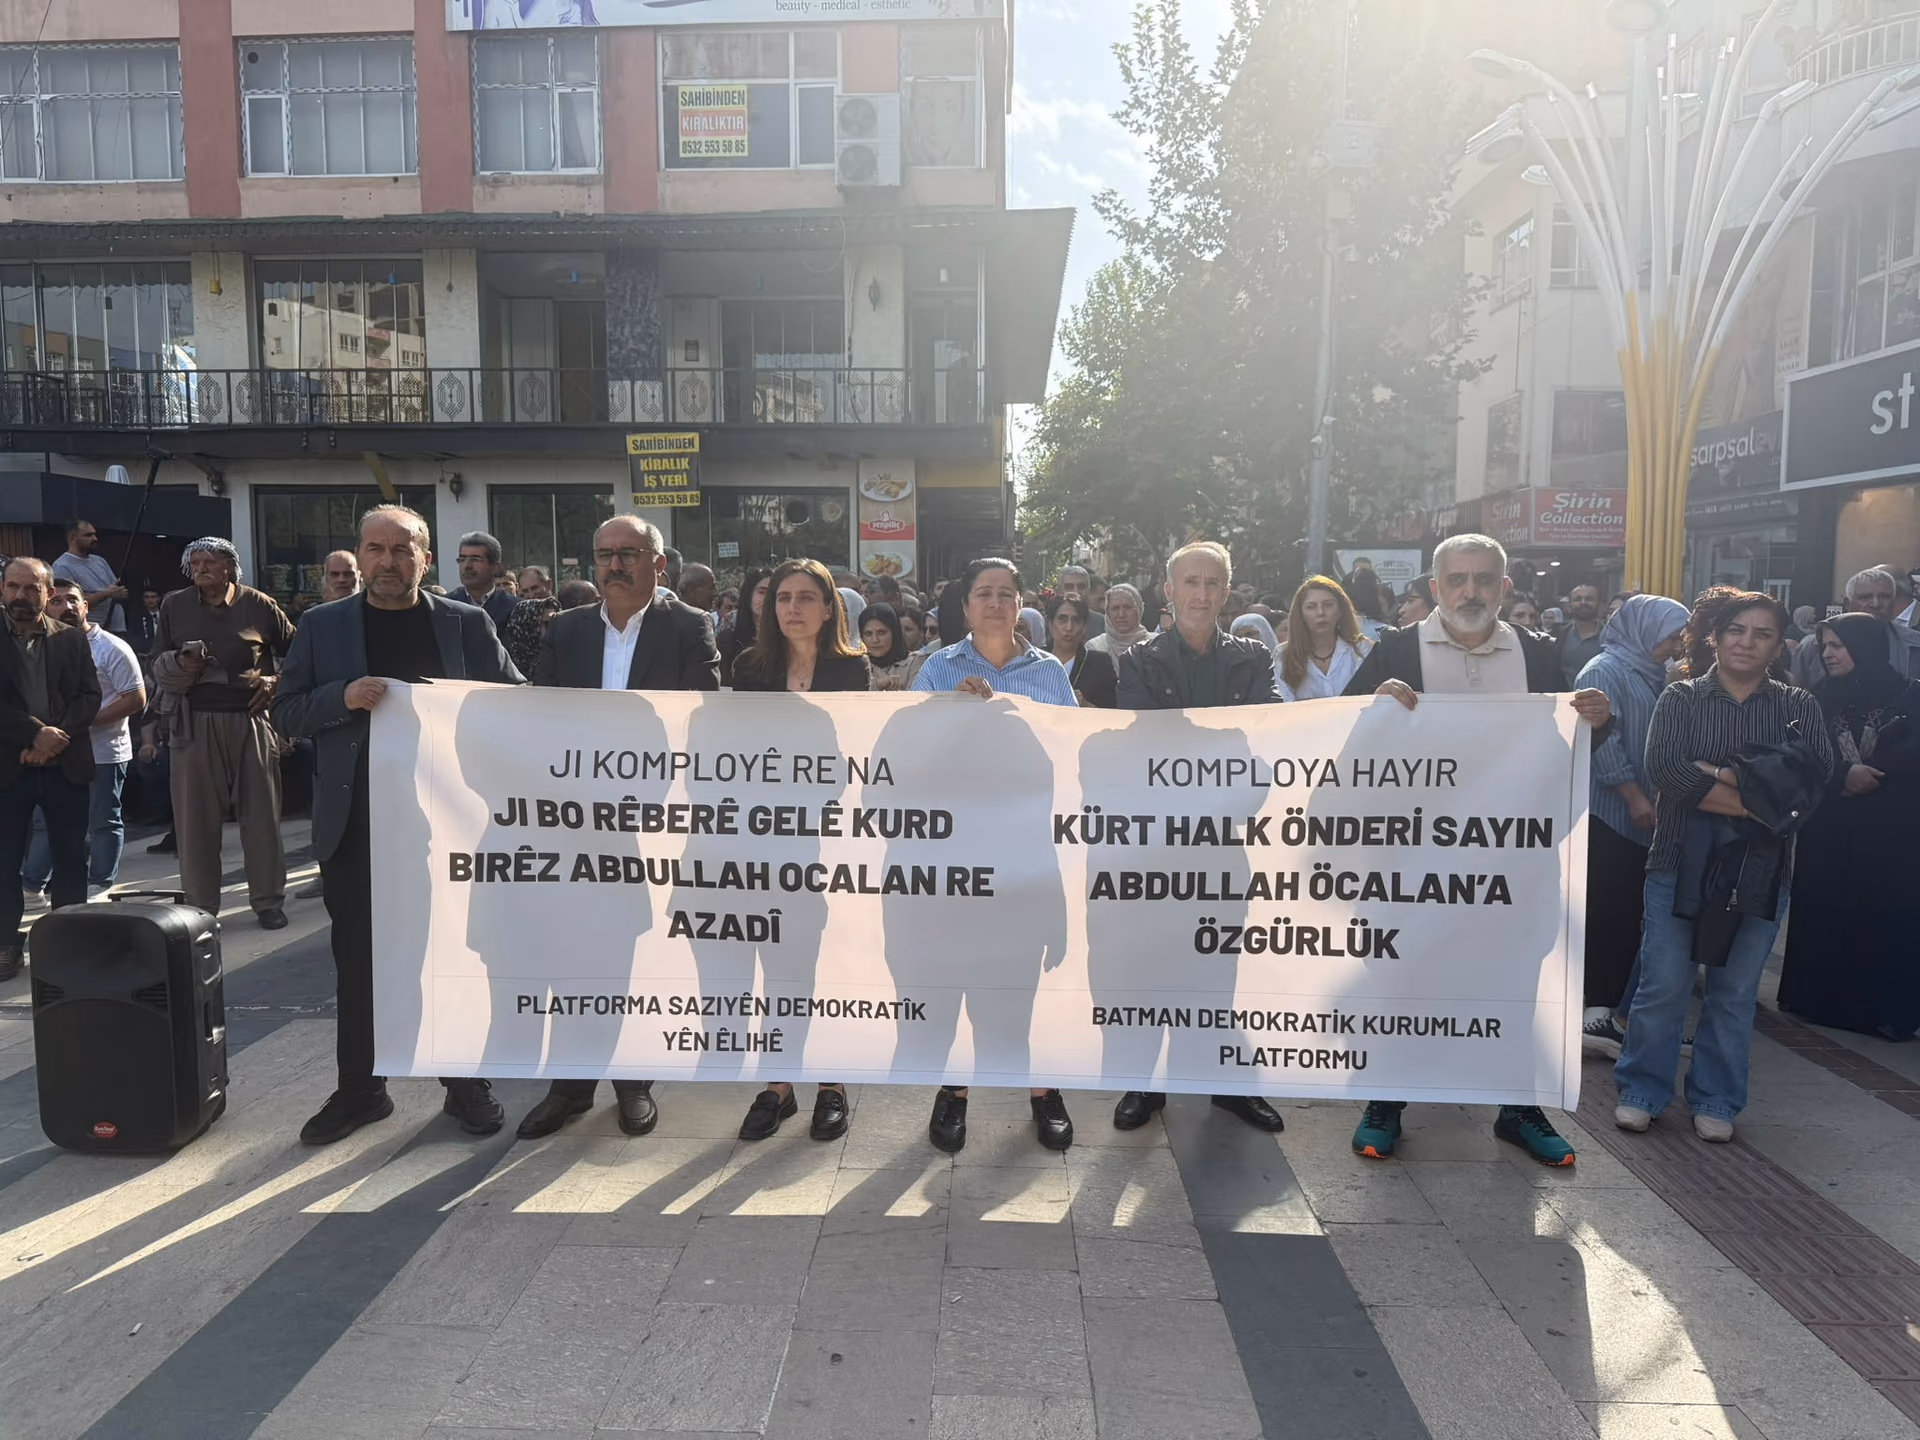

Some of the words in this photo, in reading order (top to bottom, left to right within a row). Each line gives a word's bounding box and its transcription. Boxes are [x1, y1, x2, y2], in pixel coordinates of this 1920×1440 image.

[775, 0, 811, 13] beauty
[820, 0, 861, 10] medical
[680, 88, 745, 106] SAHİBİNDEN
[682, 140, 703, 154] 0532
[704, 139, 720, 153] 553
[722, 139, 732, 153] 58
[735, 139, 745, 153] 85
[632, 436, 695, 451] SAHİBİNDEN
[640, 457, 690, 471] KİRALIK
[659, 472, 688, 487] YERİ
[633, 495, 656, 505] 0532
[658, 495, 674, 505] 553
[676, 494, 688, 504] 58
[1553, 492, 1611, 512] Şirin
[1540, 512, 1623, 524] Collection
[550, 750, 581, 778] JI
[594, 747, 781, 782] KOMPLOYÊ
[793, 755, 836, 784] RE
[848, 757, 894, 785] NA
[1149, 759, 1340, 787] KOMPLOYA
[1353, 759, 1457, 787] HAYIR
[494, 798, 528, 826] JI
[536, 799, 584, 829] BO
[593, 796, 739, 834] RÊBERÊ
[748, 800, 843, 836] GELÊ
[853, 808, 952, 839] KURD
[1055, 805, 1155, 845] KÜRT
[1166, 816, 1272, 846] HALK
[1282, 807, 1422, 846] ÖNDERİ
[1432, 816, 1552, 848] SAYIN
[450, 846, 560, 882] BIRÊZ
[570, 853, 769, 890] ABDULLAH
[779, 863, 936, 895] OCALAN
[947, 867, 994, 897] RE
[1089, 872, 1299, 900] ABDULLAH
[668, 909, 782, 943] AZADÎ
[1195, 917, 1400, 959] ÖZGÜRLÜK
[518, 995, 661, 1015] PLATFORMA
[669, 992, 770, 1016] SAZIYÊN
[777, 997, 926, 1020] DEMOKRATÎK
[1093, 1007, 1190, 1027] BATMAN
[1198, 1009, 1356, 1034] DEMOKRATİK
[1363, 1015, 1501, 1038] KURUMLAR
[663, 1027, 709, 1051] YÊN
[716, 1027, 783, 1052] ÊLIHÊ
[1220, 1046, 1367, 1070] PLATFORMU
